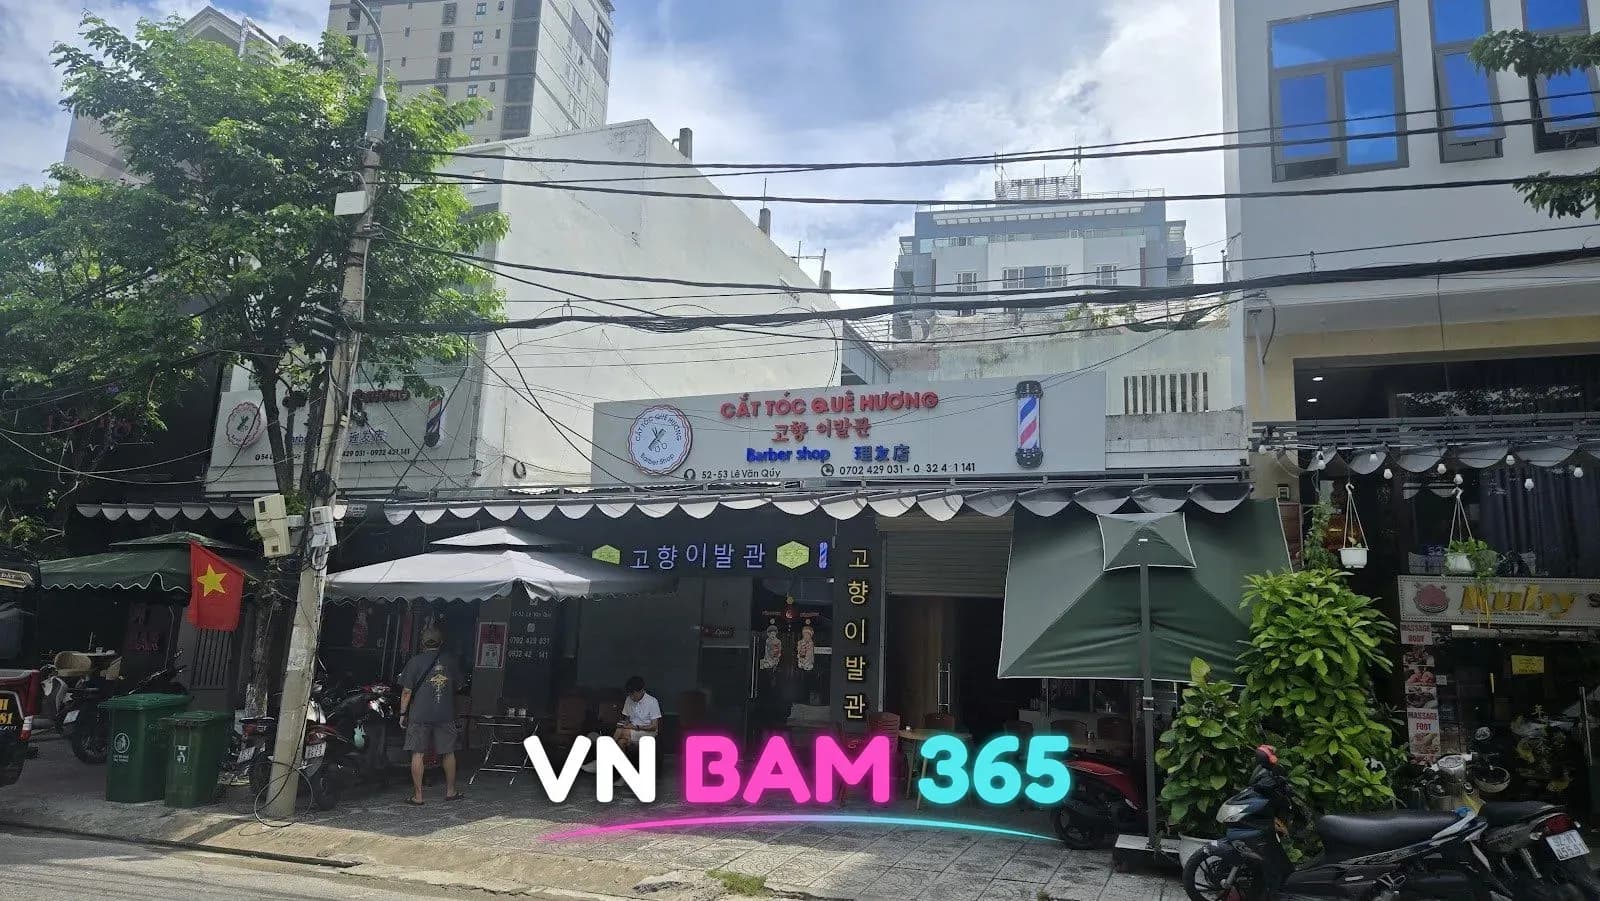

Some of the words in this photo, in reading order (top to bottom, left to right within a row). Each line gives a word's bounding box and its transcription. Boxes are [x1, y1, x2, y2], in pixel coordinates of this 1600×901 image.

[765, 390, 807, 416] TÓC
[811, 388, 855, 413] QUÊ
[860, 390, 939, 411] HƯƠNG
[771, 421, 809, 442] 고향
[746, 447, 794, 462] Barber
[796, 446, 831, 463] shop
[731, 469, 741, 478] Lê
[742, 469, 759, 478] Văn
[839, 466, 863, 476] 0702
[867, 465, 883, 475] 429
[887, 464, 903, 474] 031
[1408, 711, 1438, 721] MASSAGE
[1416, 722, 1432, 731] FOOT
